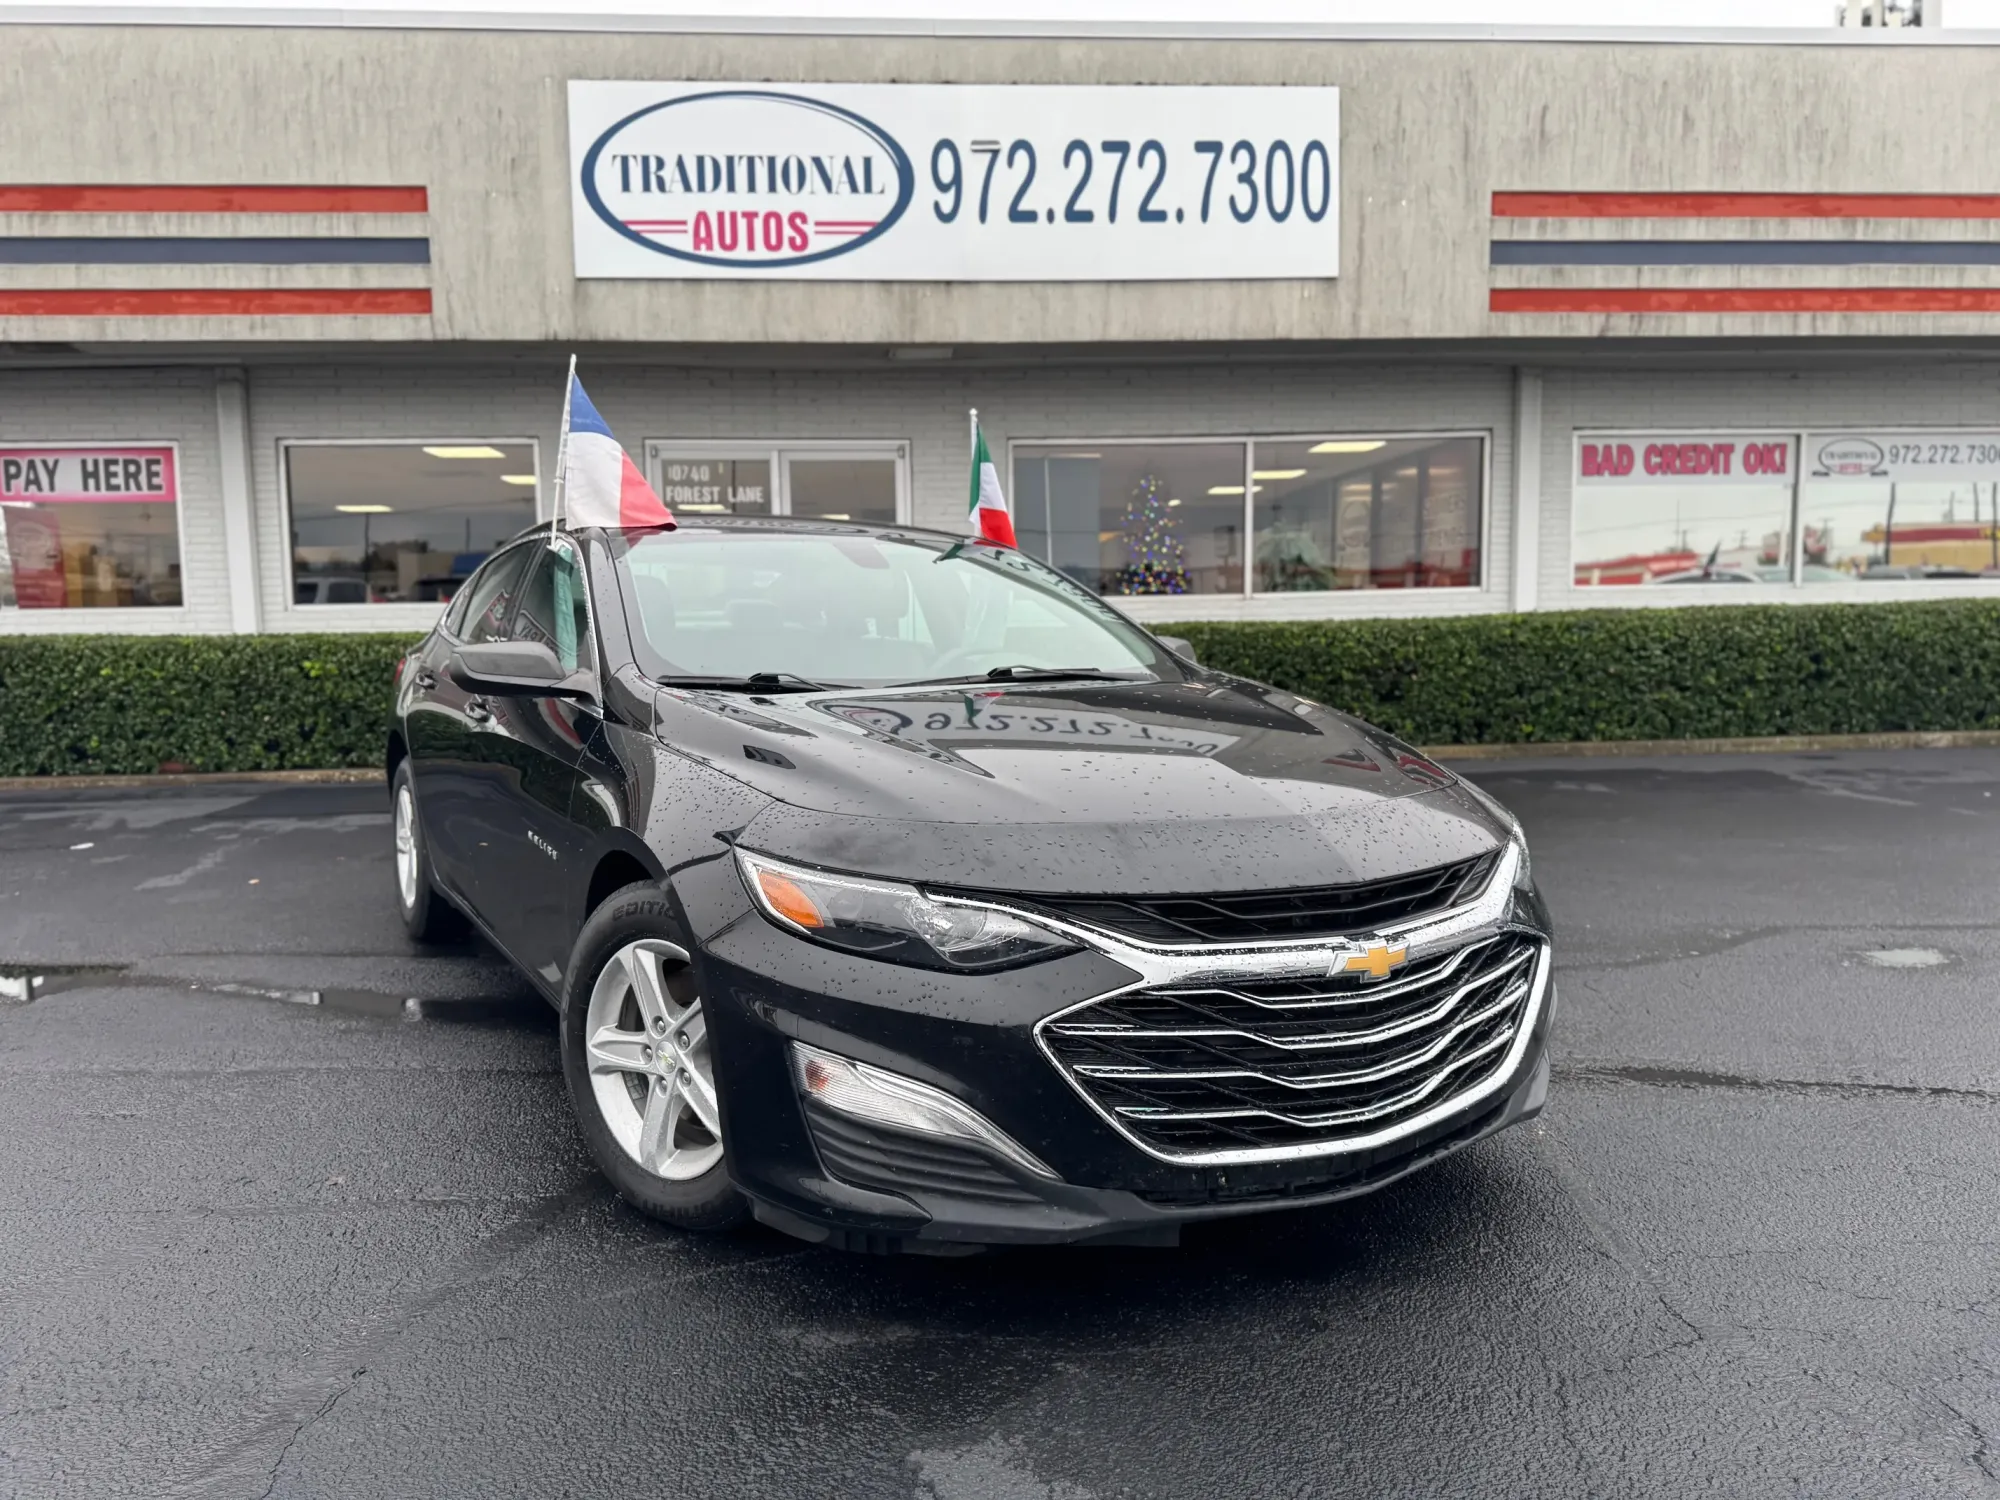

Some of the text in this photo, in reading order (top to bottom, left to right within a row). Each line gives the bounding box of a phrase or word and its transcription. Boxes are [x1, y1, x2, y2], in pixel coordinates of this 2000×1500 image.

[612, 154, 885, 195] TRADITIONAL
[930, 138, 1331, 224] 972.272.7300
[693, 211, 809, 252] AUTOS
[1582, 443, 1788, 476] BAD CREDIT OK!
[1889, 444, 2000, 464] 972.272.730
[3, 458, 163, 492] PAY HERE
[665, 486, 764, 503] FOREST LANE
